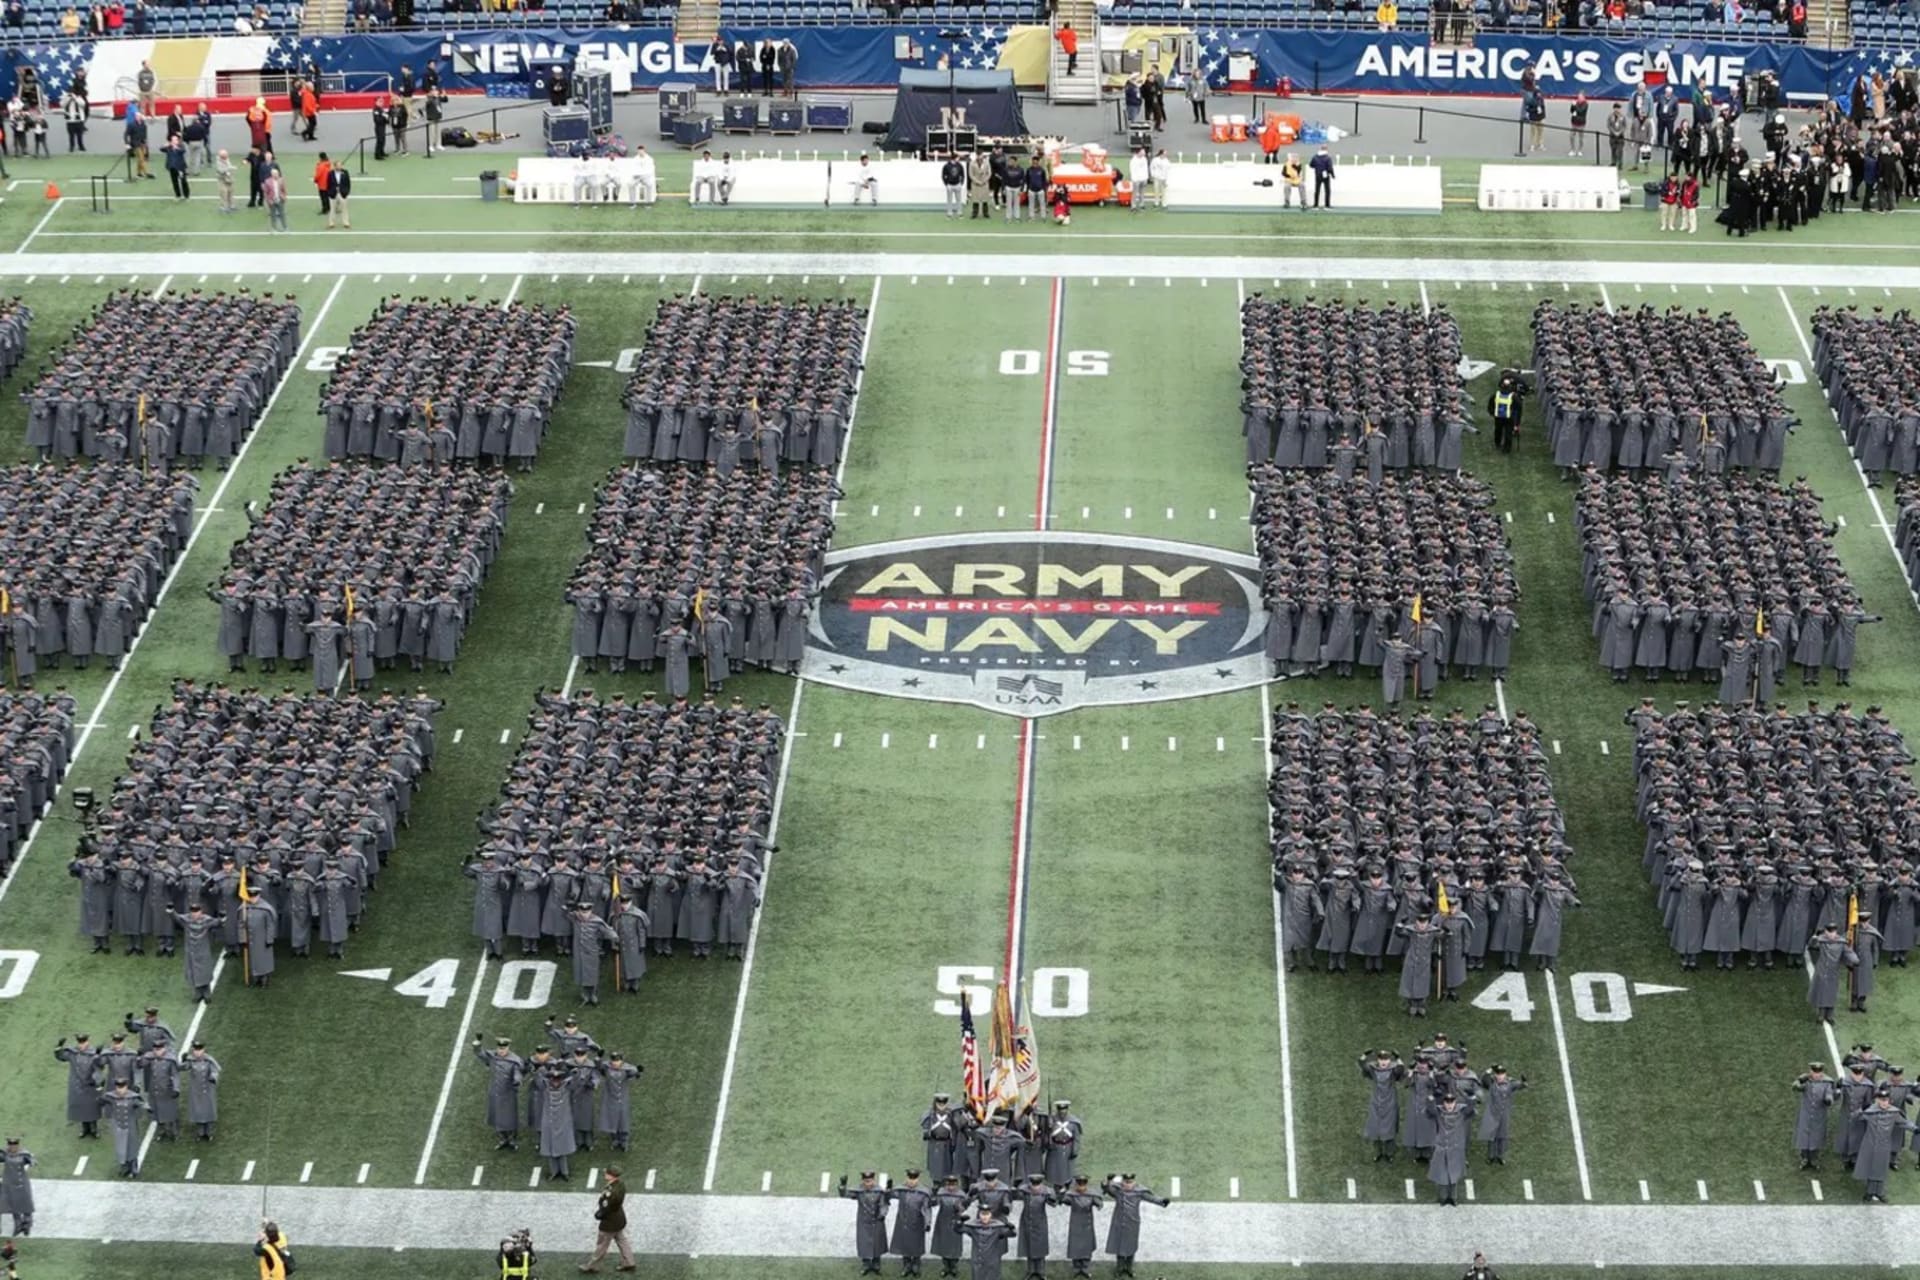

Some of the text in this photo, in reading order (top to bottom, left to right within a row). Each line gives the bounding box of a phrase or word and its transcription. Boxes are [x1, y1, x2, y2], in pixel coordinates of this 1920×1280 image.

[455, 43, 565, 73] NEW
[1355, 44, 1745, 87] AMERICA'S GAME
[855, 562, 1210, 598] ARMY
[880, 601, 1189, 613] AMERICA'S GAME
[866, 616, 1209, 655] NAVY
[920, 657, 1087, 666] PRESENTED
[995, 694, 1062, 705] USAA
[394, 959, 557, 1009] 40
[934, 966, 1089, 1017] 50
[1471, 972, 1633, 1022] 40
